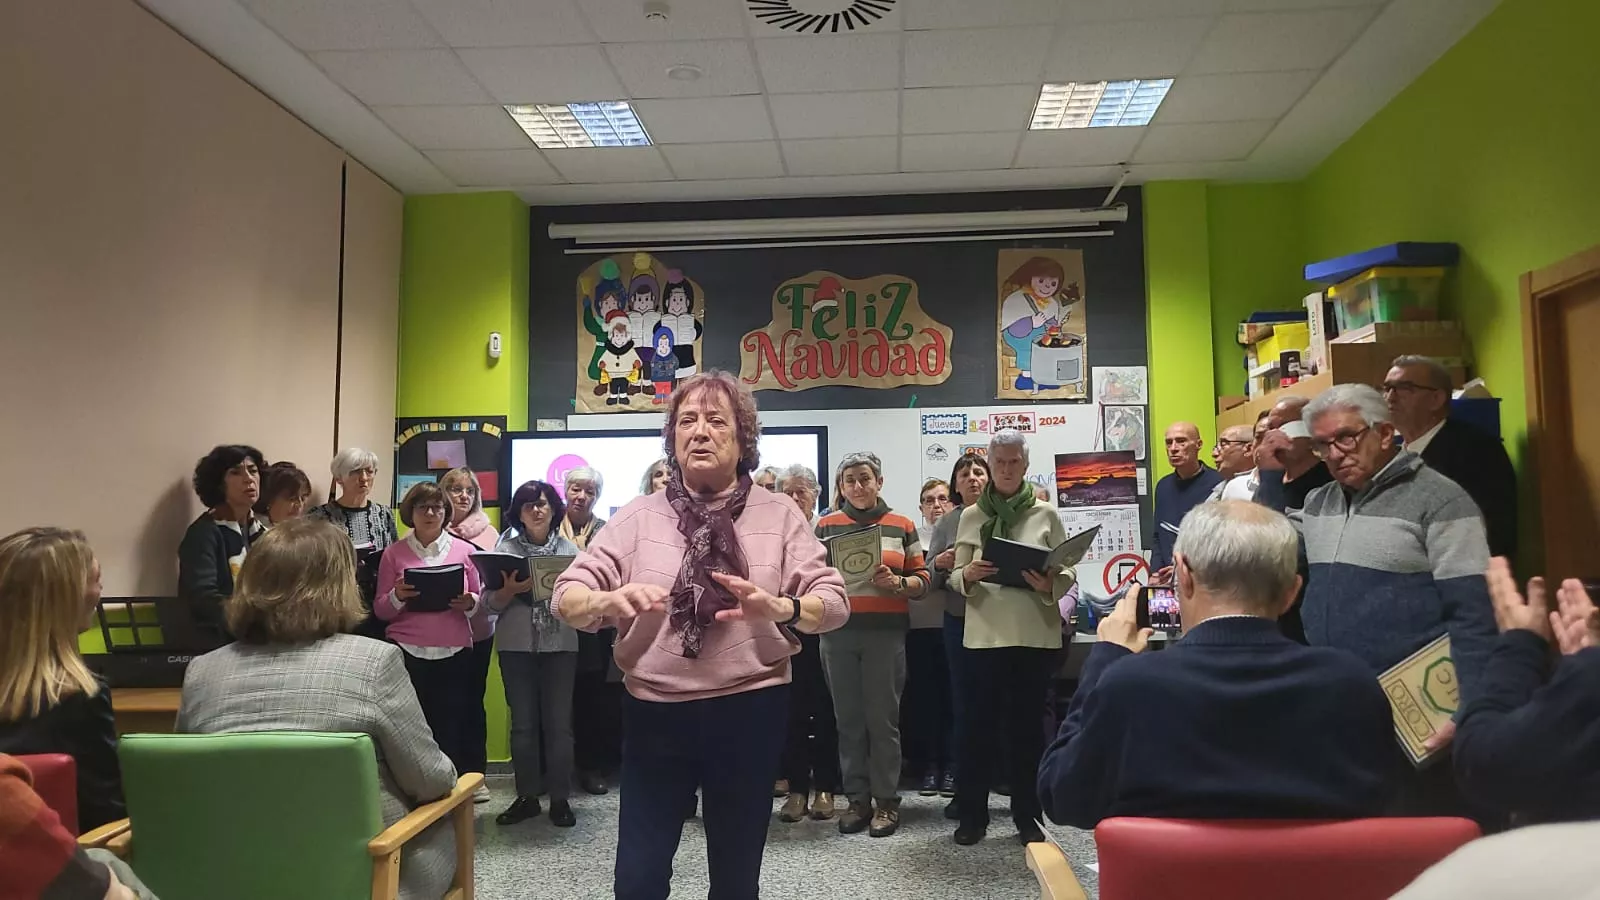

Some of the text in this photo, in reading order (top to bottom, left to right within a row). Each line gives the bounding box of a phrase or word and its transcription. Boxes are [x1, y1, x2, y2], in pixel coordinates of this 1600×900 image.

[743, 327, 945, 389] Navidad
[929, 418, 961, 429] Jueves
[1039, 415, 1066, 426] 2024
